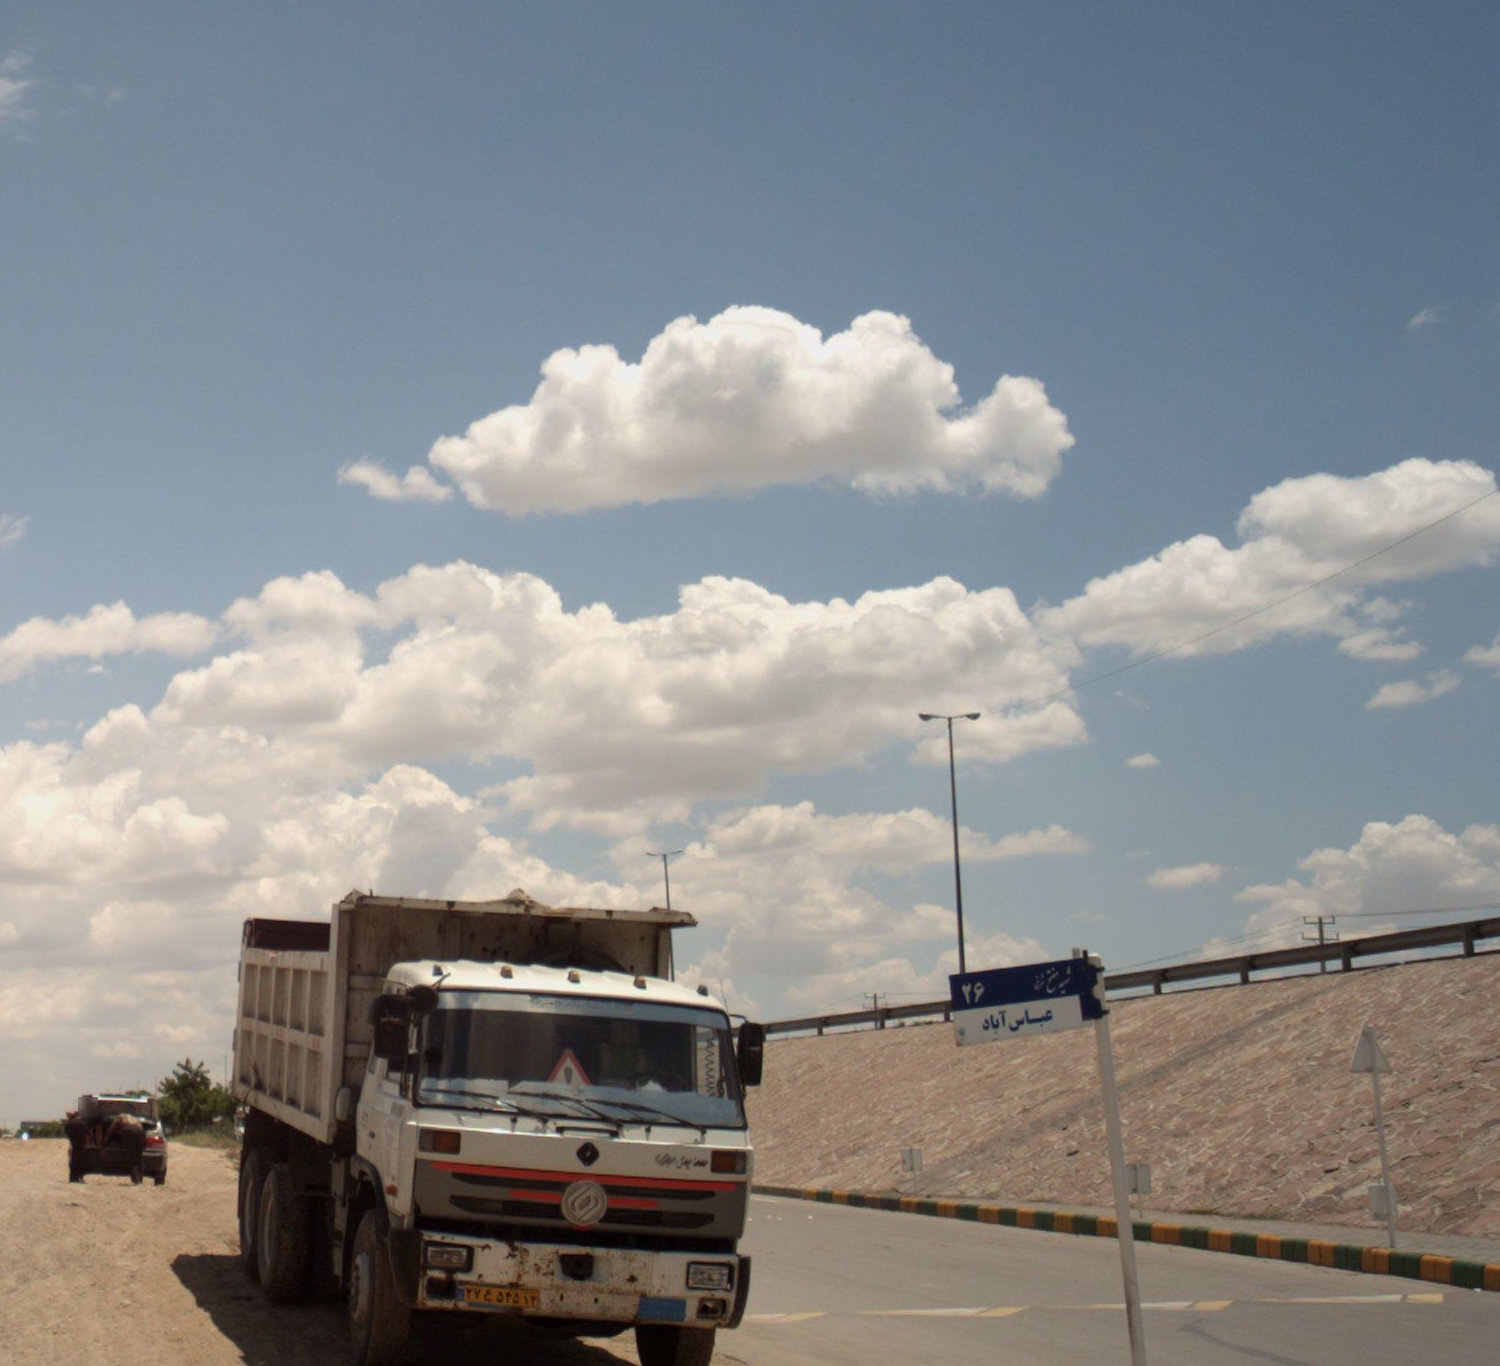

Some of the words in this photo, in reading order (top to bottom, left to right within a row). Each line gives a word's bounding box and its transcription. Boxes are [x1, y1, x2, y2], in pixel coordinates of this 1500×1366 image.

[1045, 967, 1060, 994] مفتح
[1057, 967, 1072, 994] شهید
[961, 982, 985, 1004] ۲۶
[982, 1010, 1006, 1033] آباد
[1009, 1009, 1053, 1031] عباس
